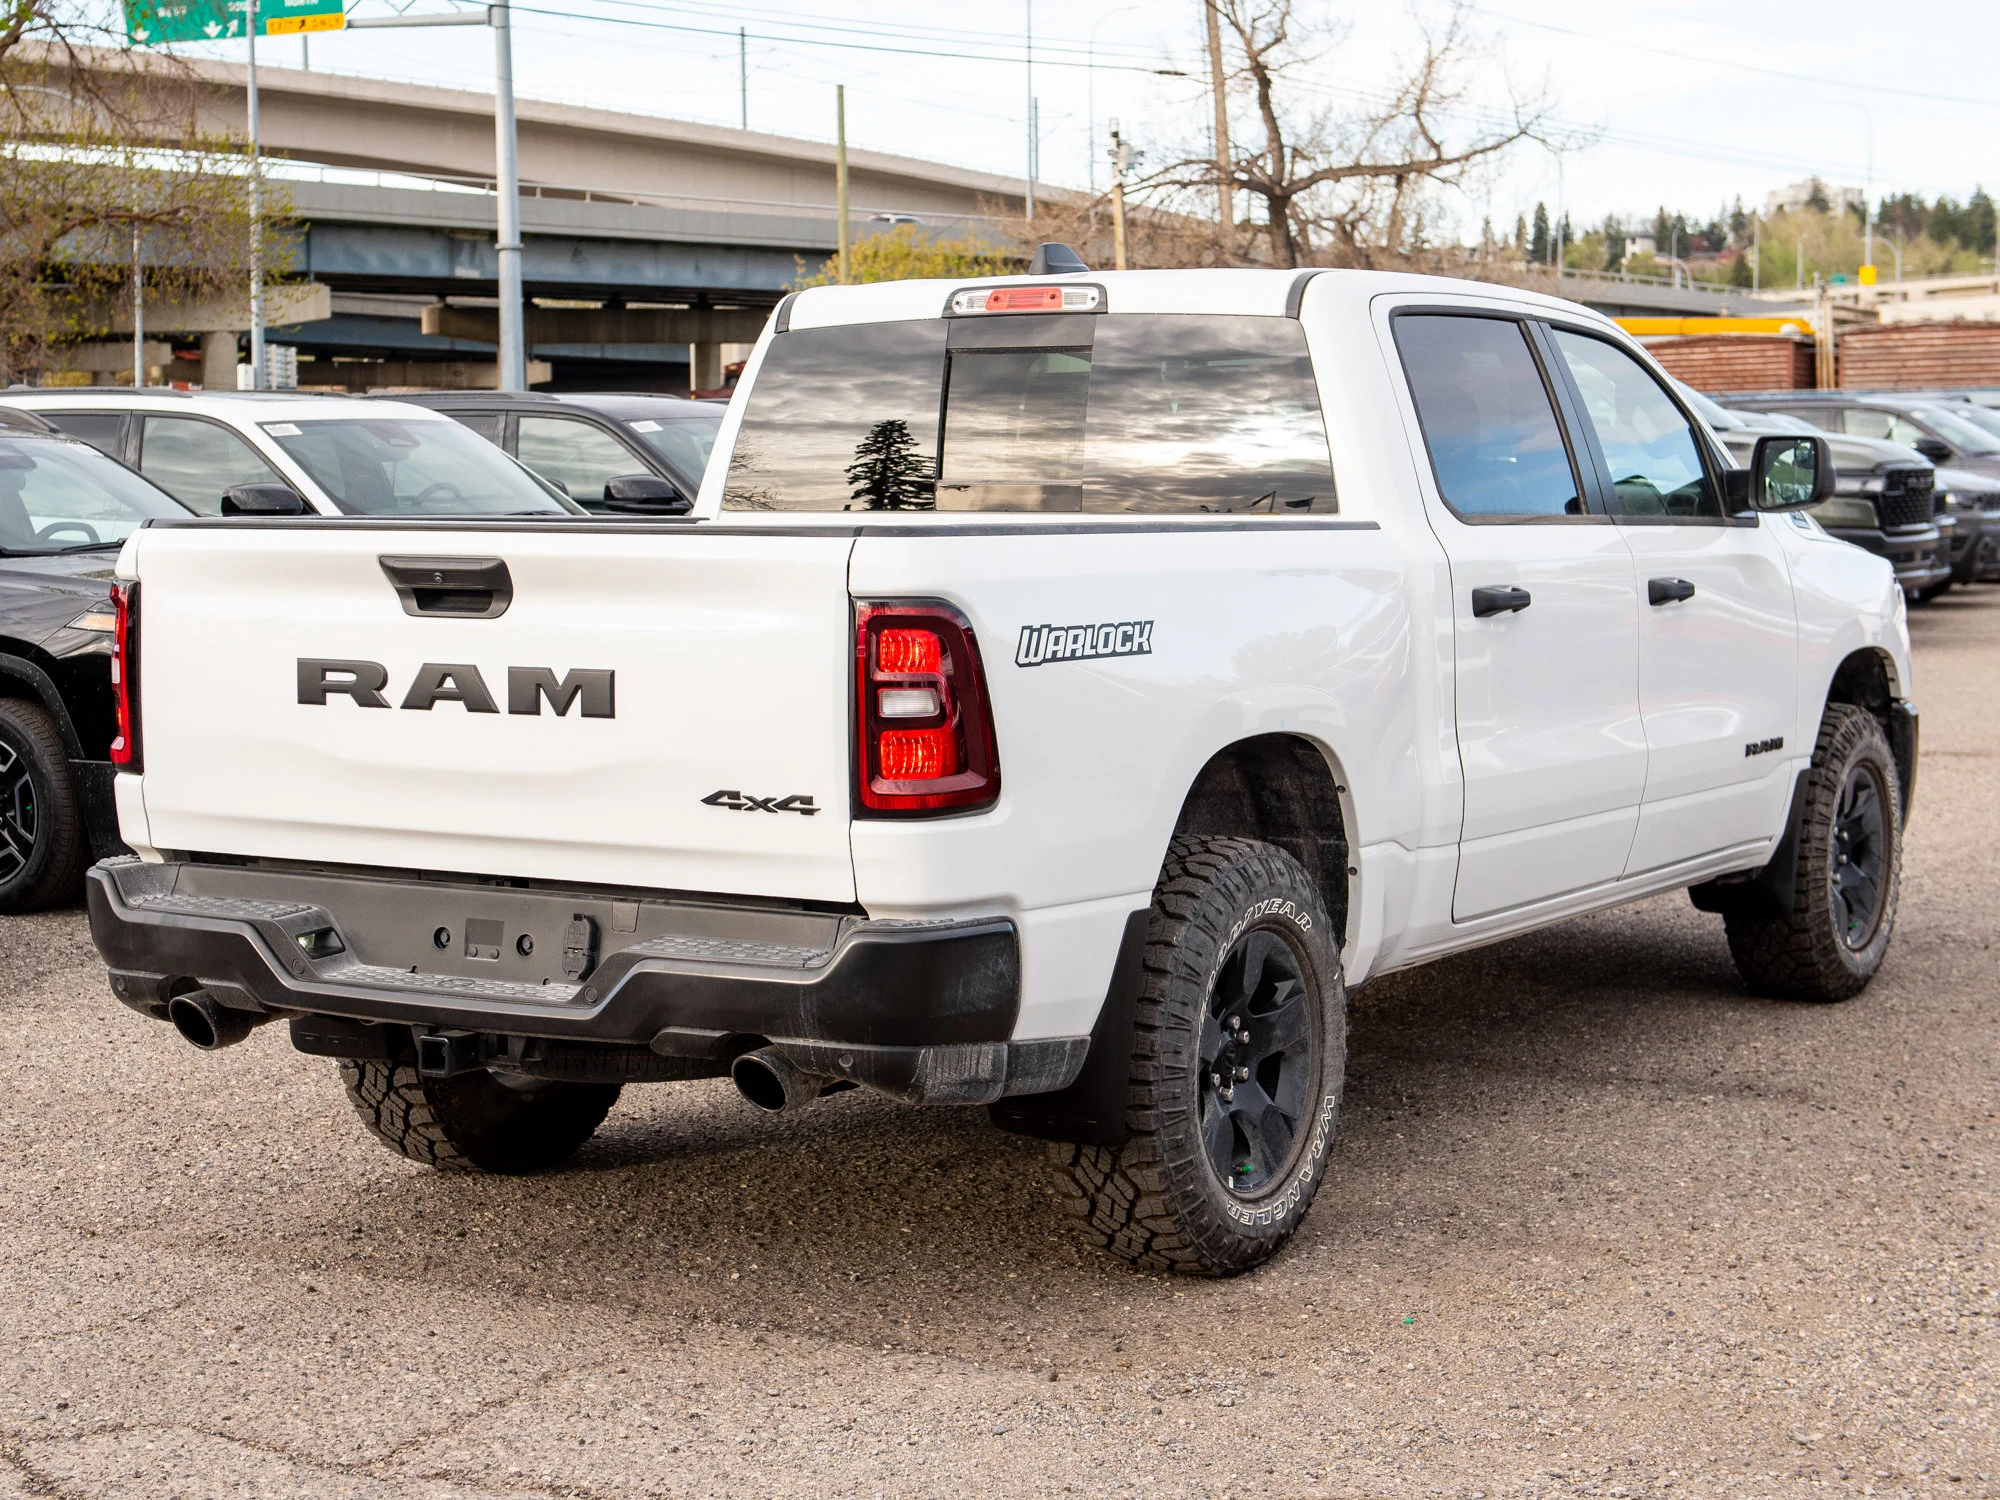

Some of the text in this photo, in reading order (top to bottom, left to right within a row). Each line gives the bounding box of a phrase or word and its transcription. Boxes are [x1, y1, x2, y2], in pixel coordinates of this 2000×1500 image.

[1014, 620, 1154, 668] WARLOCK
[296, 657, 616, 719] RAM
[1745, 736, 1784, 758] RAM
[1226, 1095, 1336, 1226] WRANGLER
